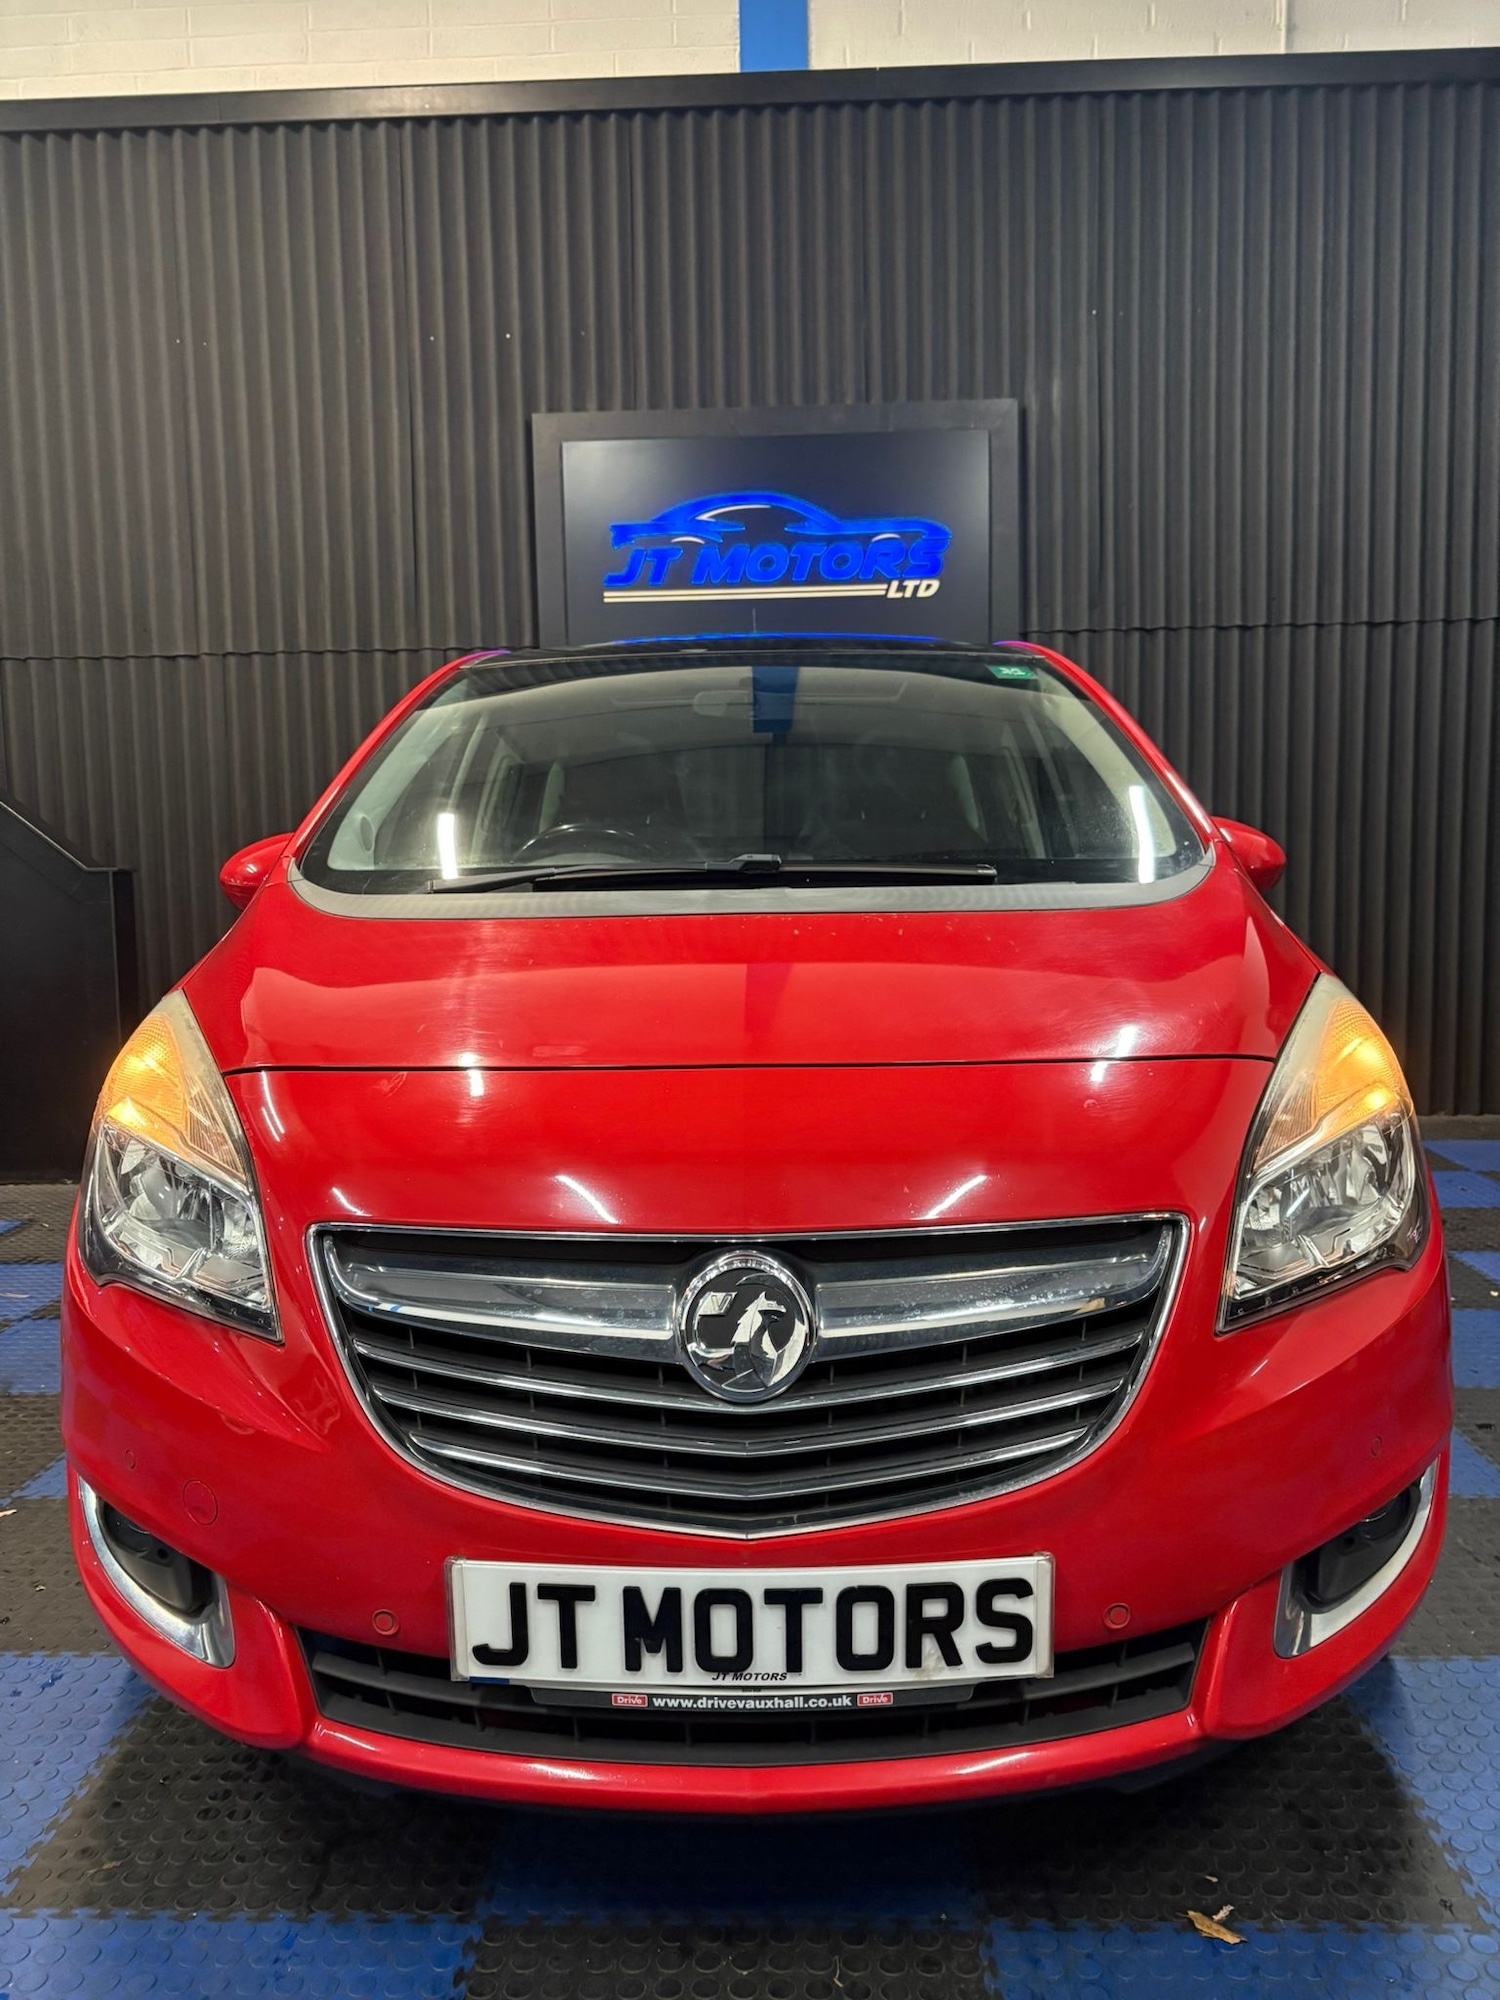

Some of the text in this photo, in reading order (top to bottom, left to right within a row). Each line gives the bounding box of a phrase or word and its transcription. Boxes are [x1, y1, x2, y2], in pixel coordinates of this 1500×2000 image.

[603, 538, 952, 587] JT MOTORS
[886, 579, 941, 599] LTD
[472, 1577, 1035, 1673] JT MOTORS
[711, 1672, 788, 1682] JT MOTORS
[617, 1693, 889, 1710] Drive www.drivevauxhall.co.uk Drive
